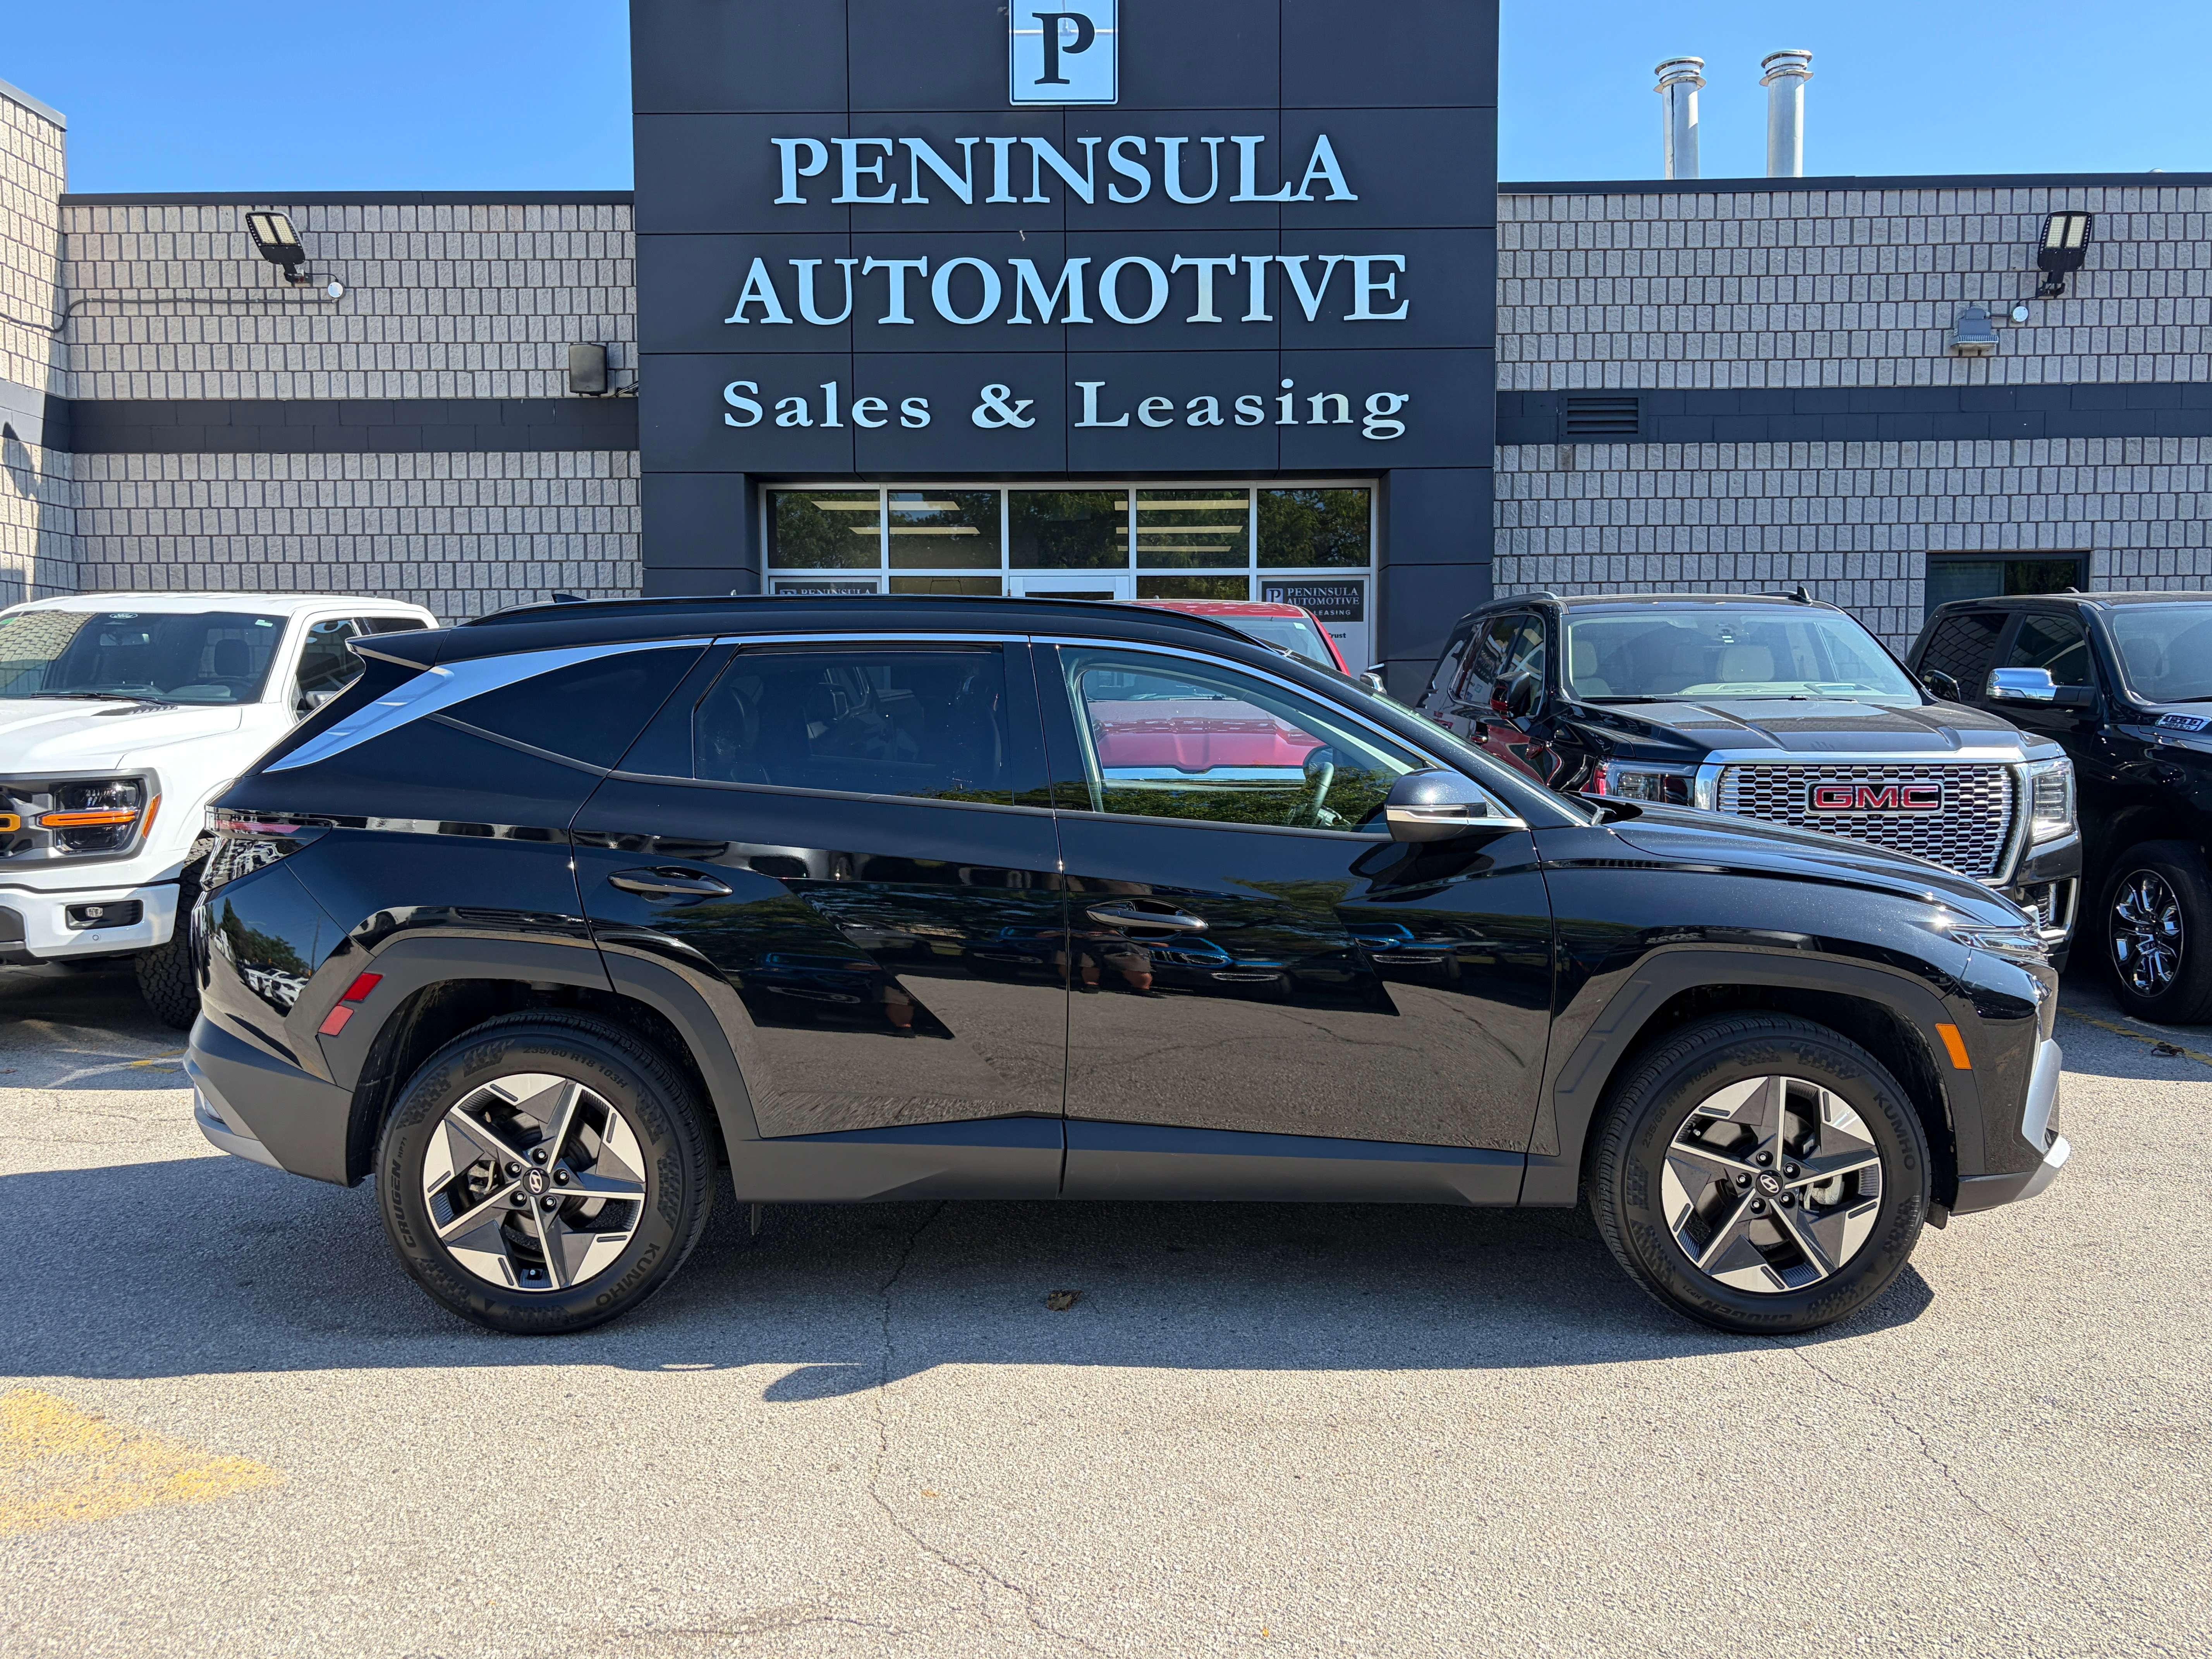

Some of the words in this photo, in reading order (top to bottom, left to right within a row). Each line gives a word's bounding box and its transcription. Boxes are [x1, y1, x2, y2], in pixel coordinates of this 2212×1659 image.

[1032, 12, 1095, 84] P
[771, 134, 1358, 204] PENINSULA
[724, 254, 1410, 326] AUTOMOTIVE
[723, 380, 931, 429] Sales
[971, 383, 1036, 429] &
[1074, 378, 1409, 440] Leasing
[1287, 587, 1358, 597] PENINSULA
[1287, 597, 1360, 605] AUTOMOTIVE
[2168, 716, 2202, 726] 1500
[1814, 785, 1939, 808] GMC
[523, 1046, 568, 1057] 235/60
[570, 1053, 596, 1068] R18
[598, 1065, 629, 1089] 103H
[398, 1137, 407, 1158] HP71
[1642, 1107, 1667, 1149] 235/60
[1666, 1088, 1686, 1107] R18
[1873, 1091, 1916, 1171] KUMHO
[391, 1158, 417, 1248] CRUGEN
[596, 1243, 661, 1306] KUMHO
